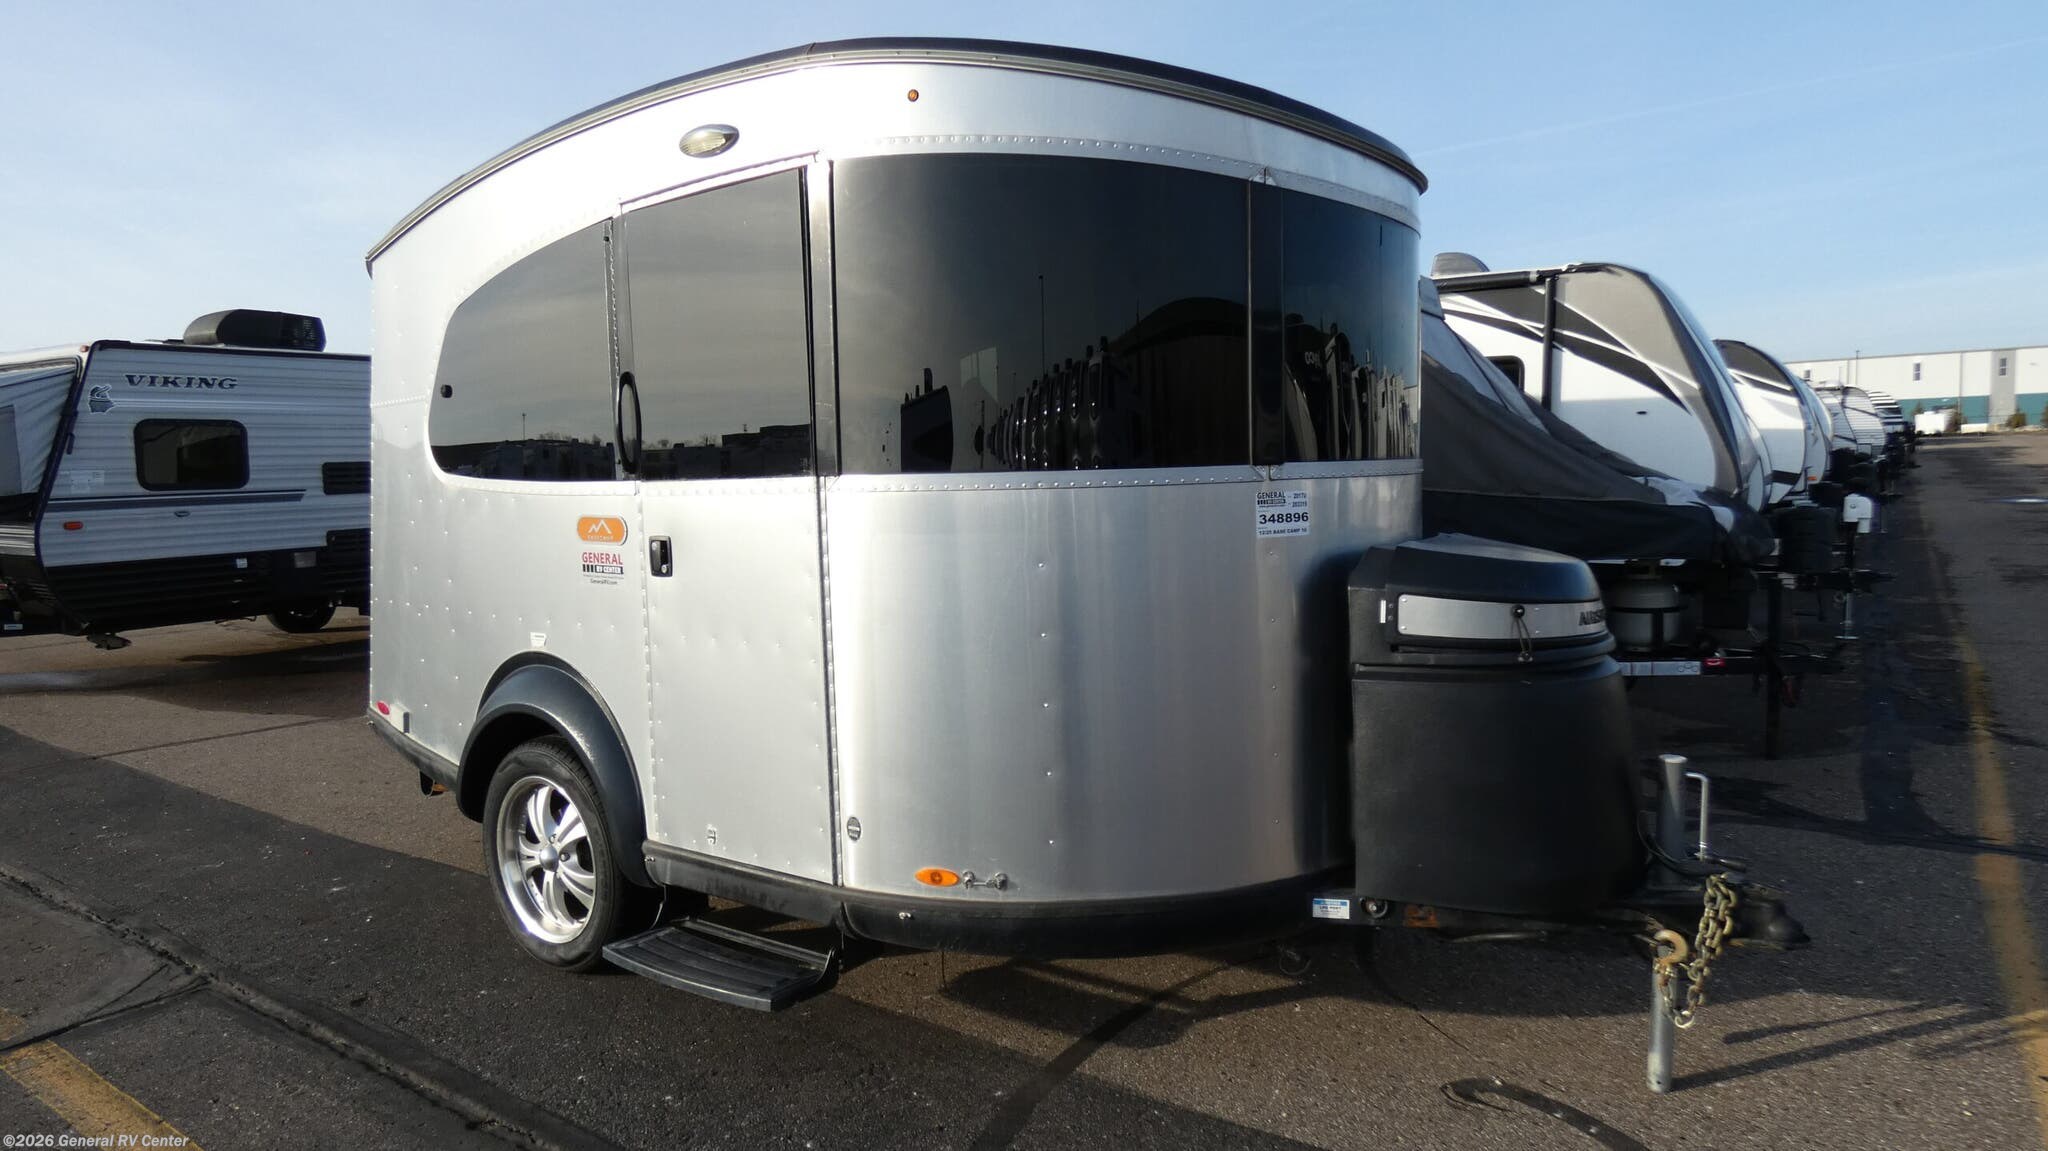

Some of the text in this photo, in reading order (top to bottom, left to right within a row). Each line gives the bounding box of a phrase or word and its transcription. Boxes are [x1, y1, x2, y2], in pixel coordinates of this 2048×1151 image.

[125, 374, 239, 390] VIKING
[1256, 491, 1286, 499] GENERAL
[1259, 511, 1309, 525] 348896
[582, 552, 623, 565] GENERAL
